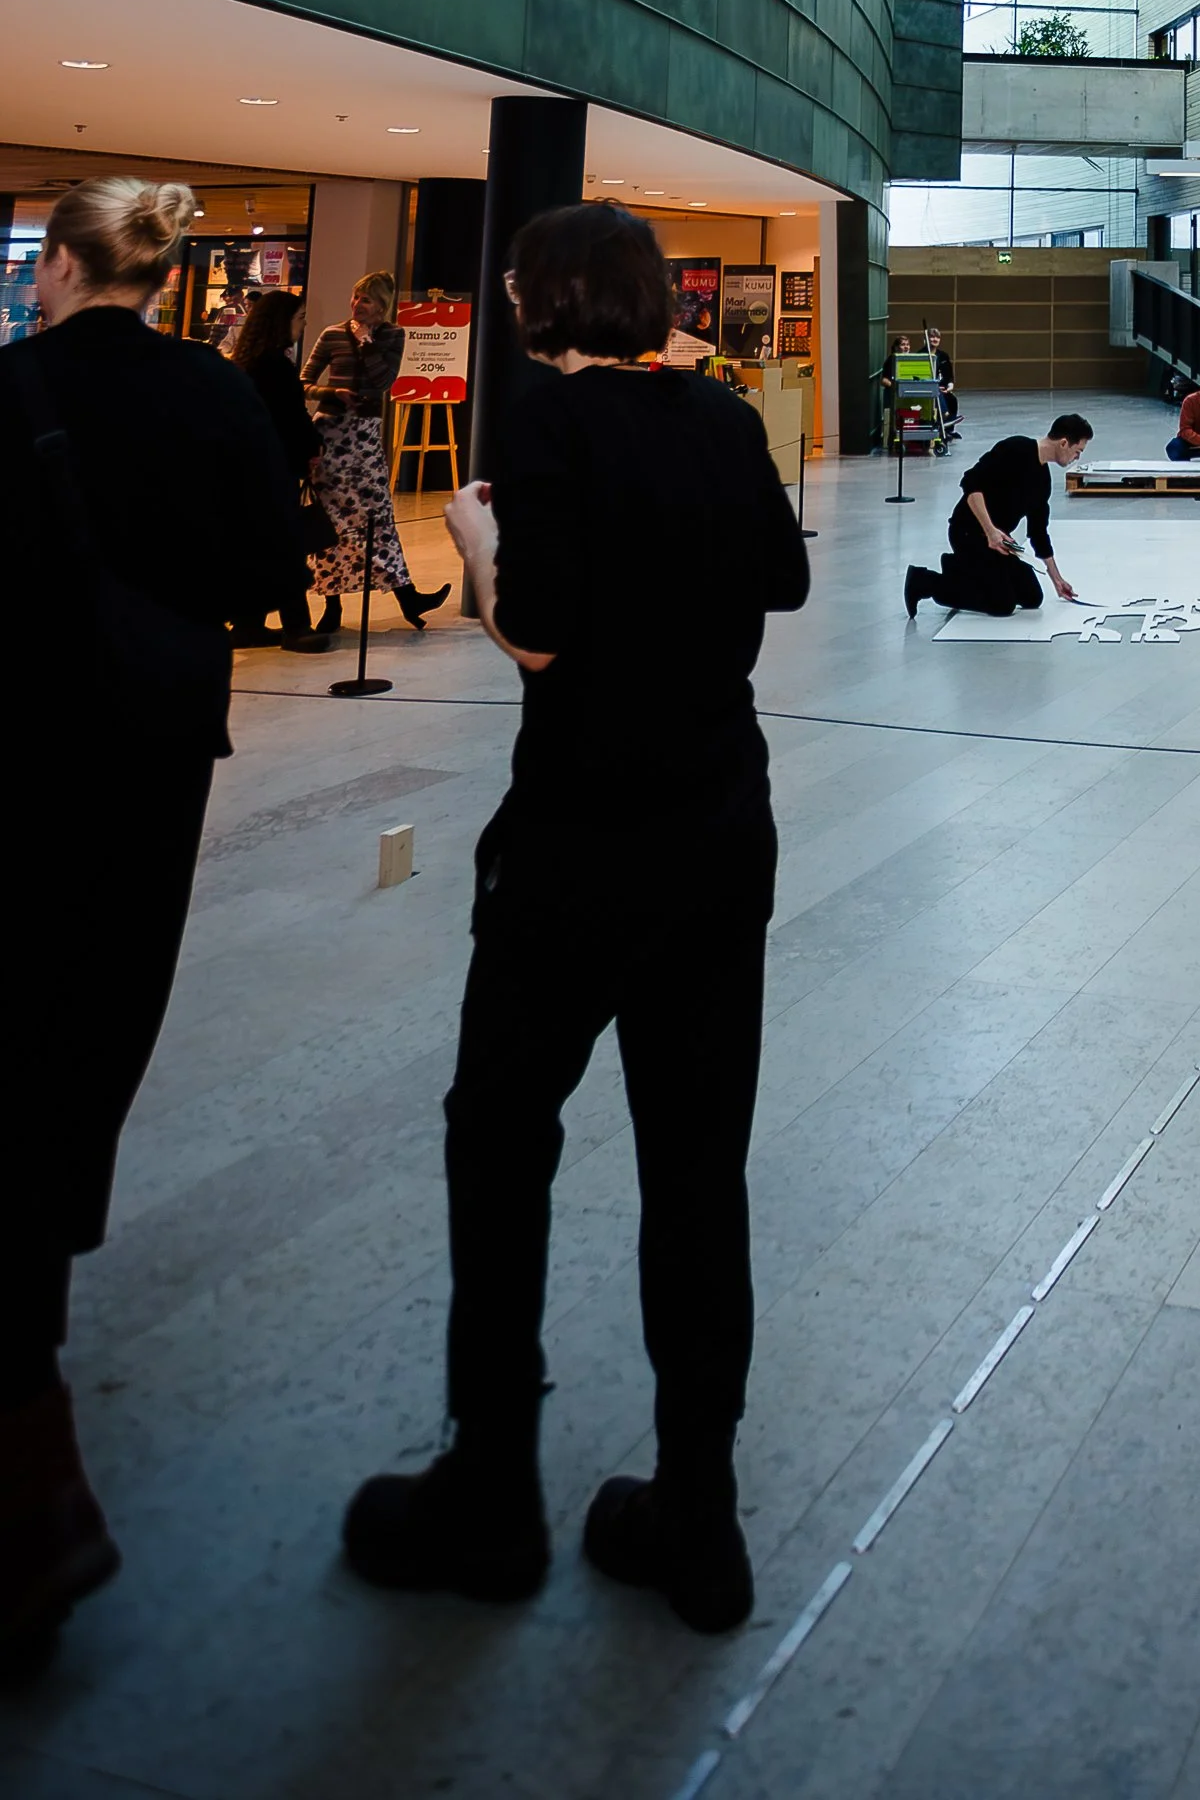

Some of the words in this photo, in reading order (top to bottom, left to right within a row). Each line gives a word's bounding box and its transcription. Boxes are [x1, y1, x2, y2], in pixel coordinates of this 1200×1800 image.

[684, 278, 717, 288] KUMU
[744, 282, 772, 291] KUMU
[725, 297, 746, 307] Mari
[409, 331, 440, 340] Kumu
[443, 331, 457, 340] 20
[416, 363, 446, 373] -20%
